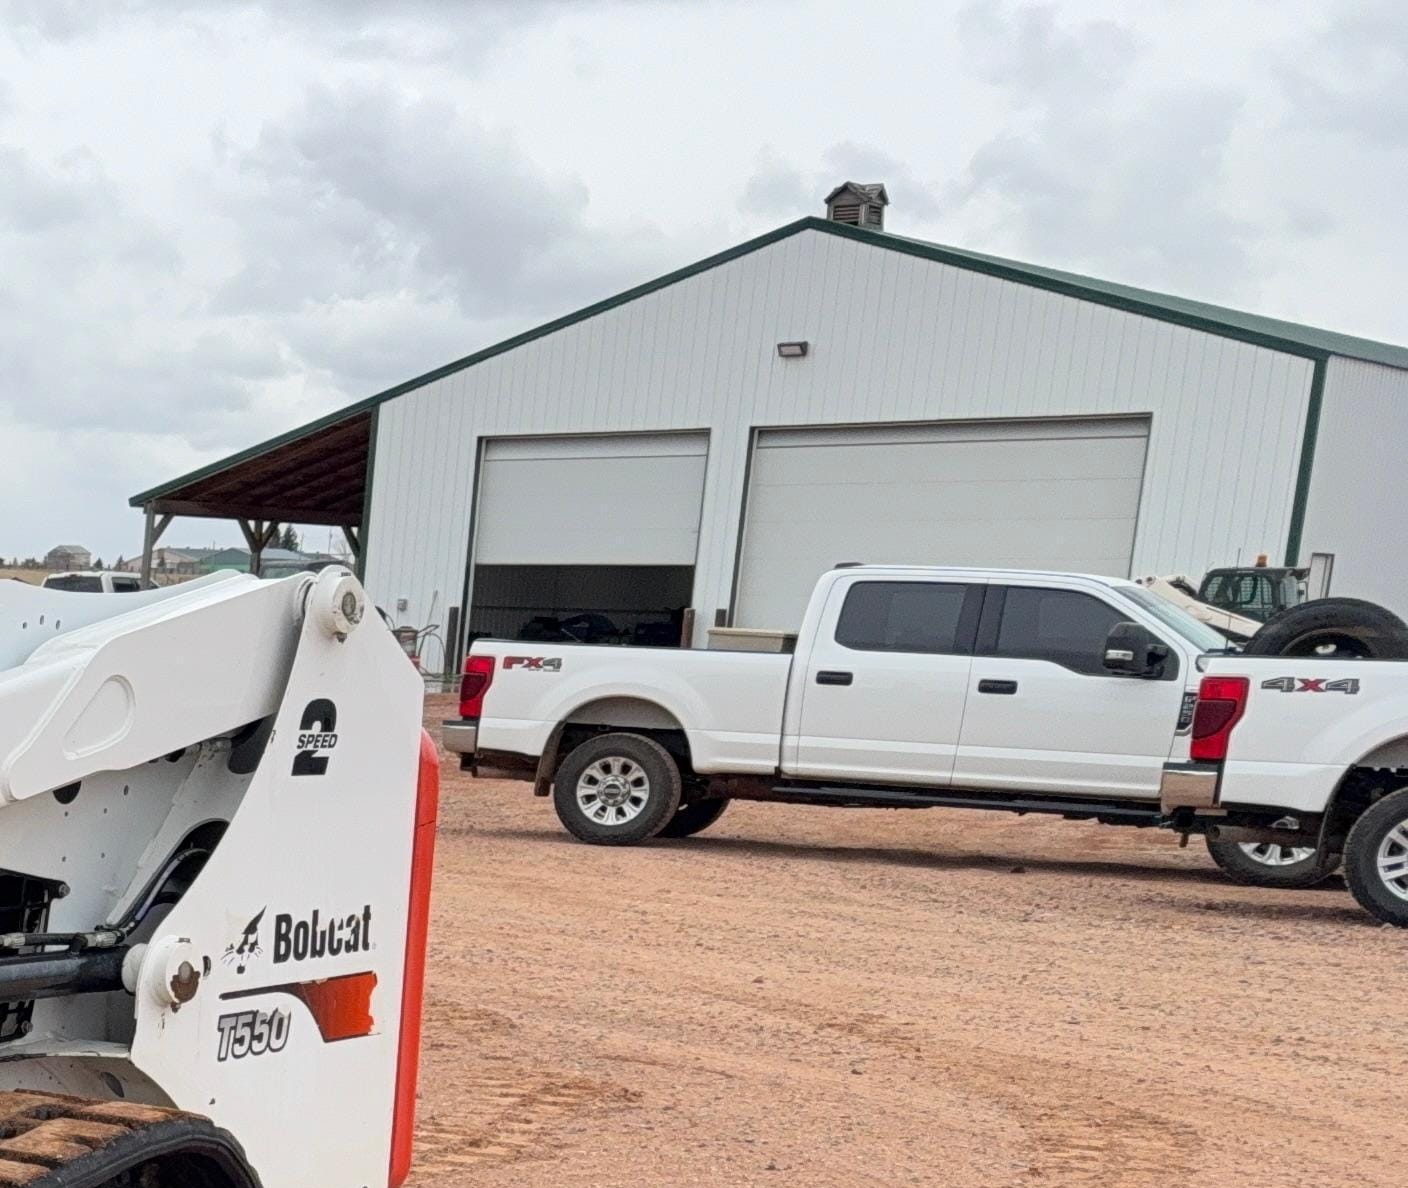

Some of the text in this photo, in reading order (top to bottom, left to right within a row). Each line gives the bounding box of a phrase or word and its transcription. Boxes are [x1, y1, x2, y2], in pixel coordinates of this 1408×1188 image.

[502, 656, 562, 669] FX4
[291, 698, 337, 776] 2
[297, 734, 338, 749] SPEED
[273, 905, 371, 963] Bobcat
[217, 1008, 291, 1062] T550
